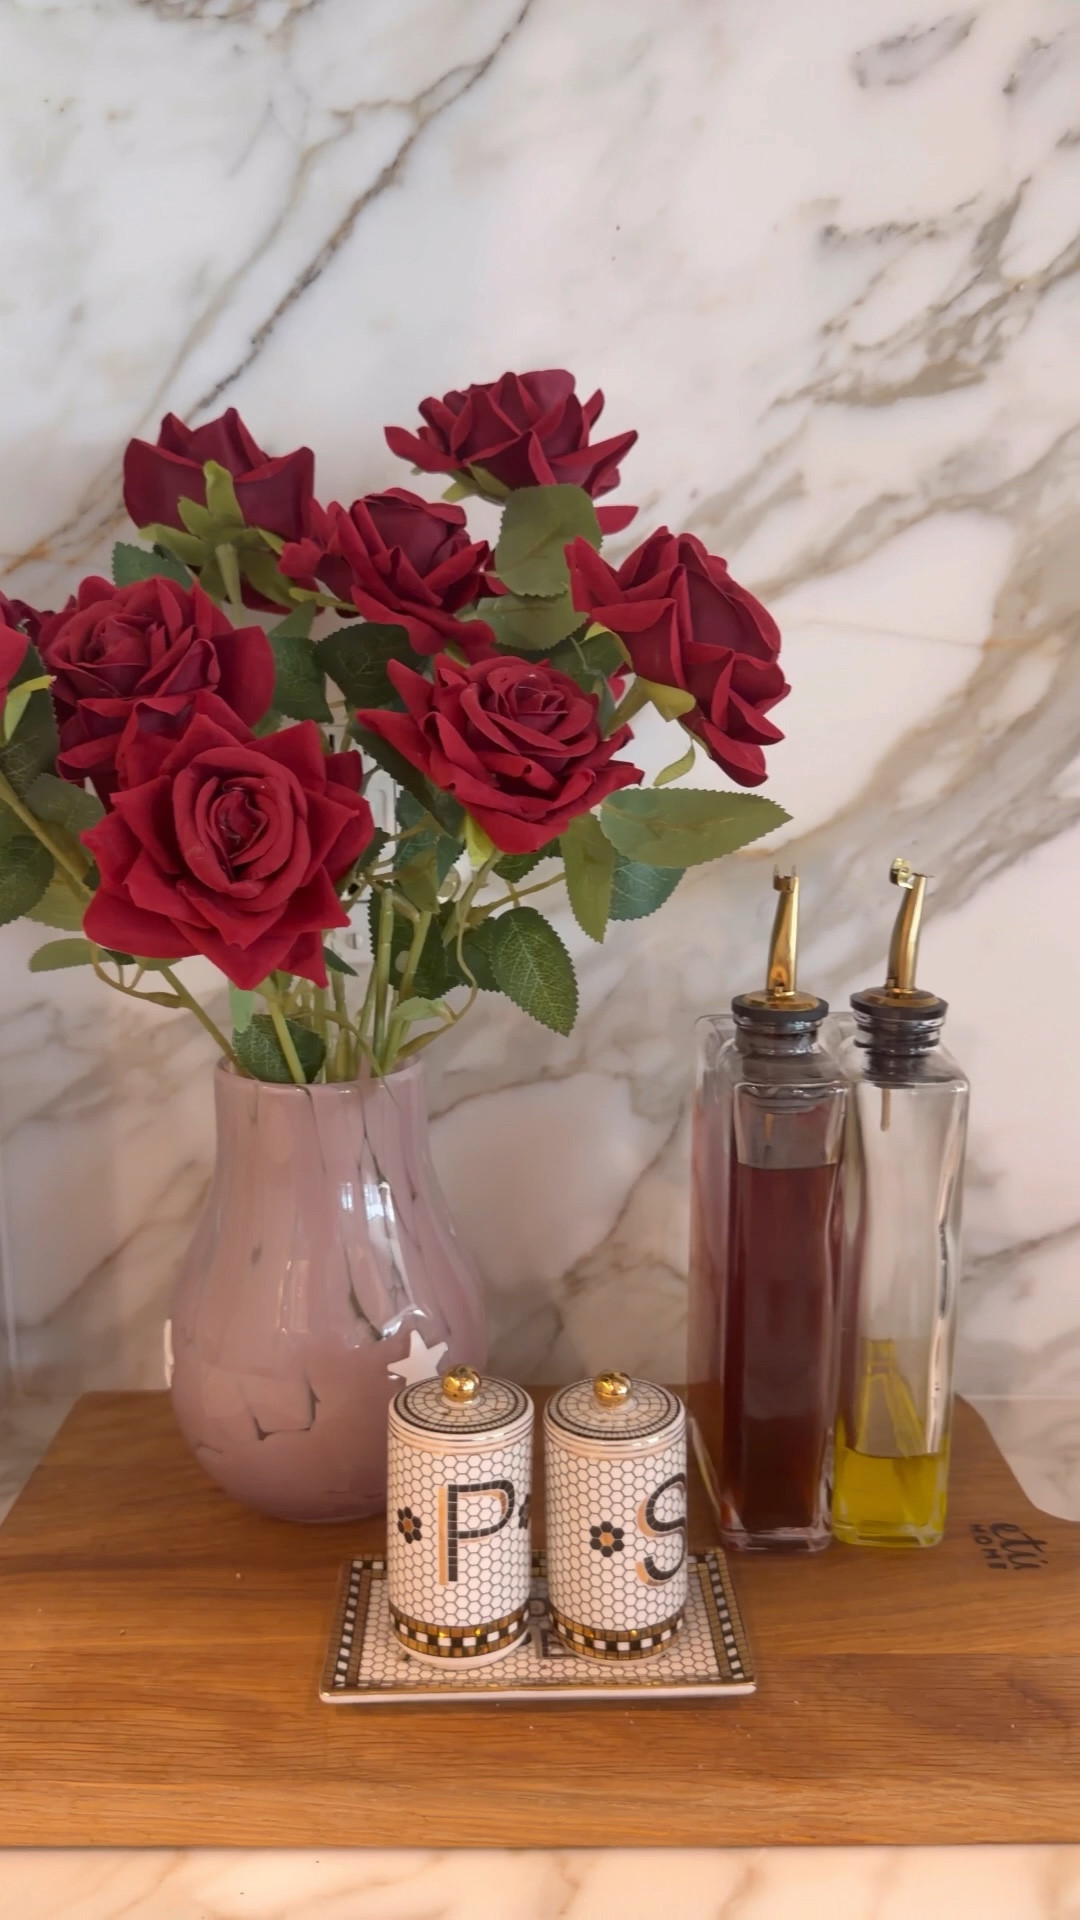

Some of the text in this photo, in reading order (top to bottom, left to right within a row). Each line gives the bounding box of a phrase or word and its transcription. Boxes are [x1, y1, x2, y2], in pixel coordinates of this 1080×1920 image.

[438, 1480, 515, 1586] P
[635, 1472, 687, 1587] S
[971, 1523, 1008, 1570] HOME
